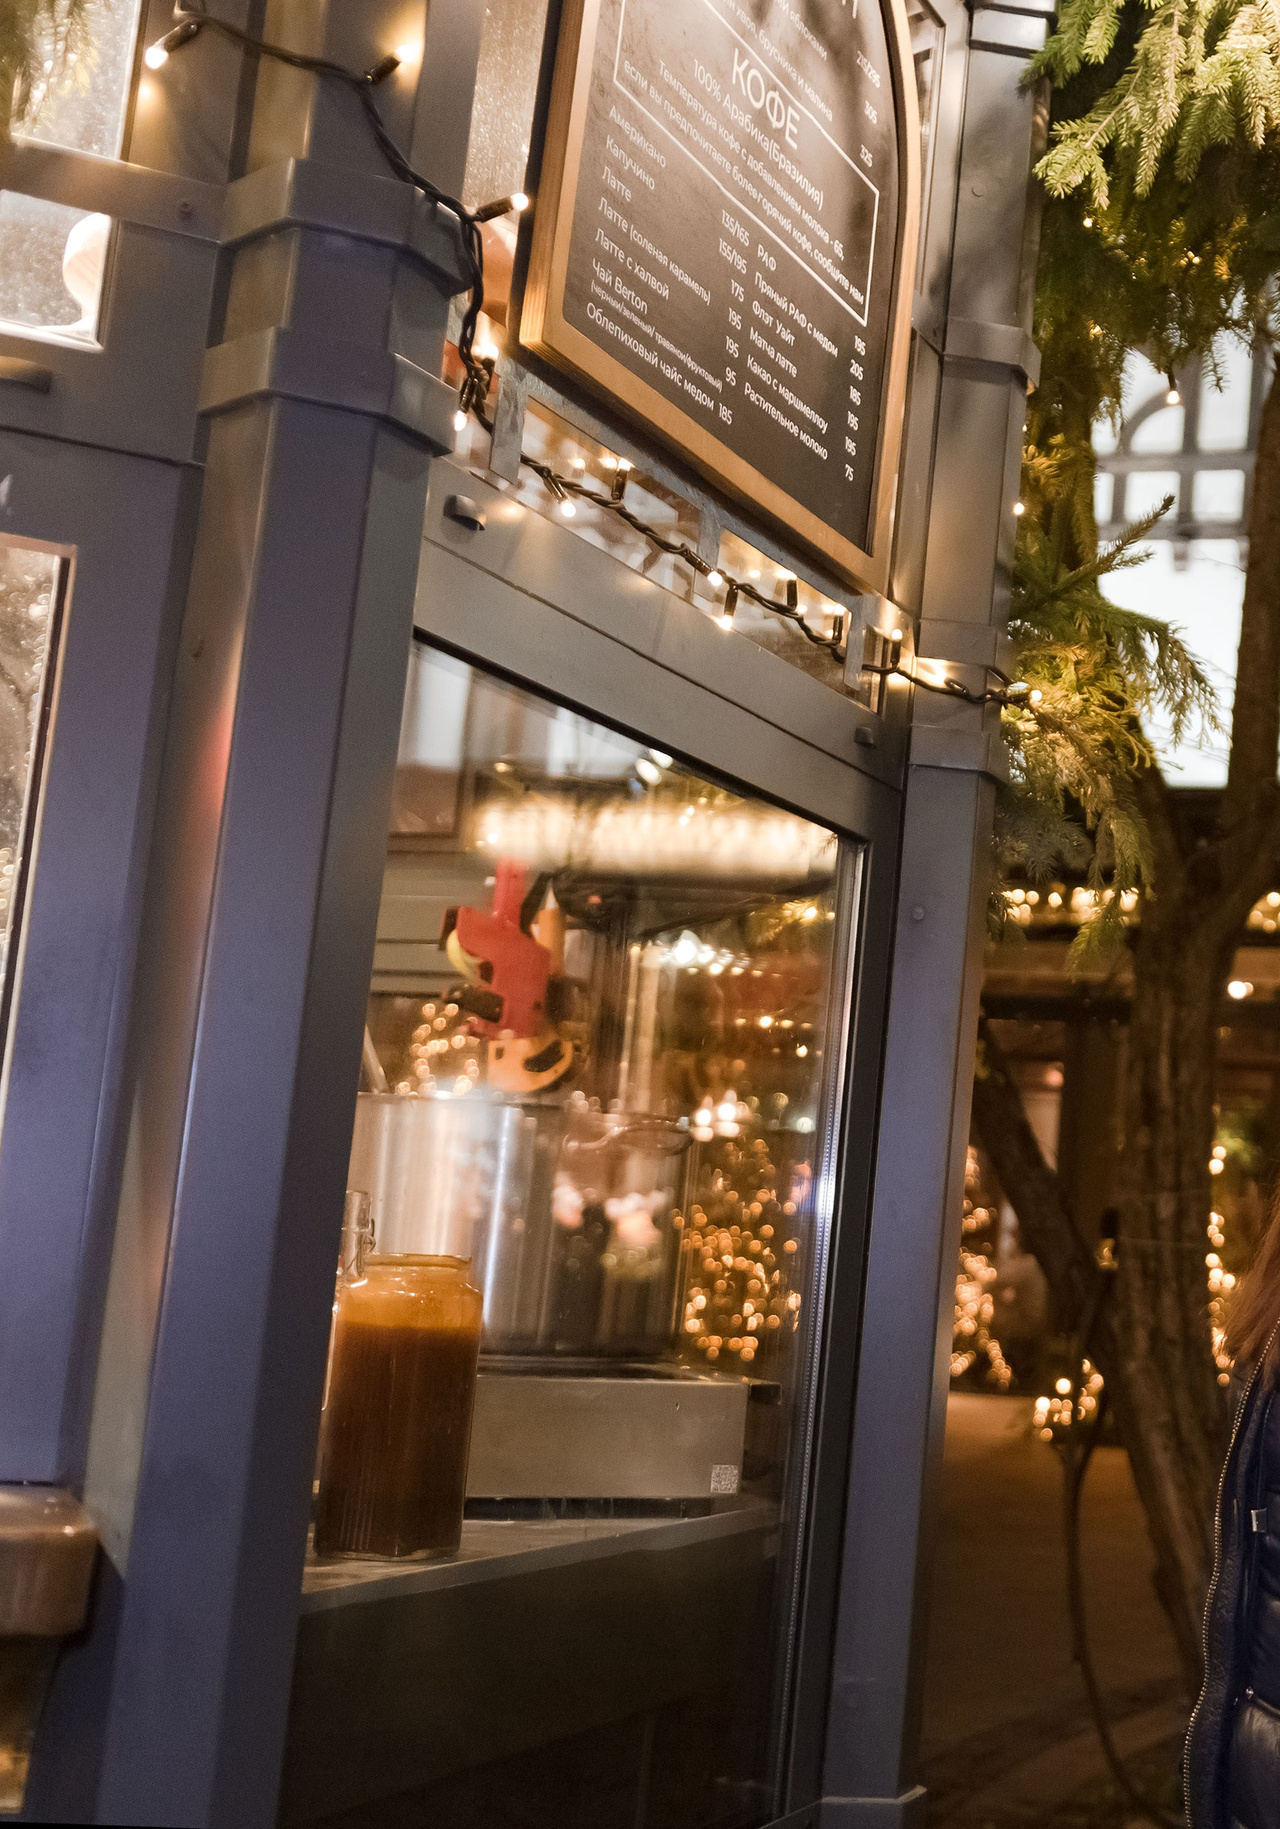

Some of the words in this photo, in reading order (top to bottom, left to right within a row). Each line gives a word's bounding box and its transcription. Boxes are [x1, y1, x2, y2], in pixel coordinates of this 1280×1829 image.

[694, 59, 722, 102] 100%
[732, 48, 800, 150] КОФЕ
[759, 29, 798, 80] брусника
[804, 84, 833, 122] малина
[606, 135, 655, 190] Капучино
[719, 238, 747, 274] 155/195
[609, 105, 666, 168] Американо
[722, 210, 749, 247] 135/165
[624, 60, 648, 91] если
[650, 85, 662, 107] вы
[664, 100, 731, 174] предпочитаете
[849, 284, 864, 305] нам
[659, 59, 717, 130] Температура
[719, 124, 741, 154] кофе
[747, 154, 802, 215] добавлением
[802, 209, 829, 244] молока
[598, 197, 628, 233] Латте
[630, 224, 669, 266] (соленая
[669, 261, 711, 306] карамель)
[728, 307, 742, 330] 195
[602, 166, 632, 202] Латте
[731, 279, 744, 302] 175
[592, 258, 612, 287] Чай
[614, 276, 648, 315] Berton
[725, 367, 737, 387] 95
[595, 228, 625, 262] Латте
[626, 256, 633, 270] с
[634, 263, 670, 300] халвой
[725, 336, 739, 358] 195
[755, 271, 788, 312] Пряный
[788, 303, 807, 328] РАФ
[813, 329, 838, 357] медом
[850, 359, 864, 381] 205
[757, 244, 777, 271] РАФ
[854, 335, 866, 356] 195
[587, 302, 658, 368] Облепиховый
[684, 379, 714, 411] медом
[719, 403, 733, 425] 185
[747, 354, 771, 385] Какао
[772, 378, 778, 391] с
[778, 385, 829, 435] маршмеллоу
[845, 436, 857, 456] 195
[750, 326, 775, 360] Матча
[775, 354, 798, 378] латте
[847, 411, 859, 431] 195
[752, 300, 774, 328] Флэт
[775, 320, 796, 346] Уайт
[850, 385, 862, 406] 185
[744, 382, 800, 437] Растительное
[800, 430, 828, 460] молоко
[845, 463, 854, 482] 75
